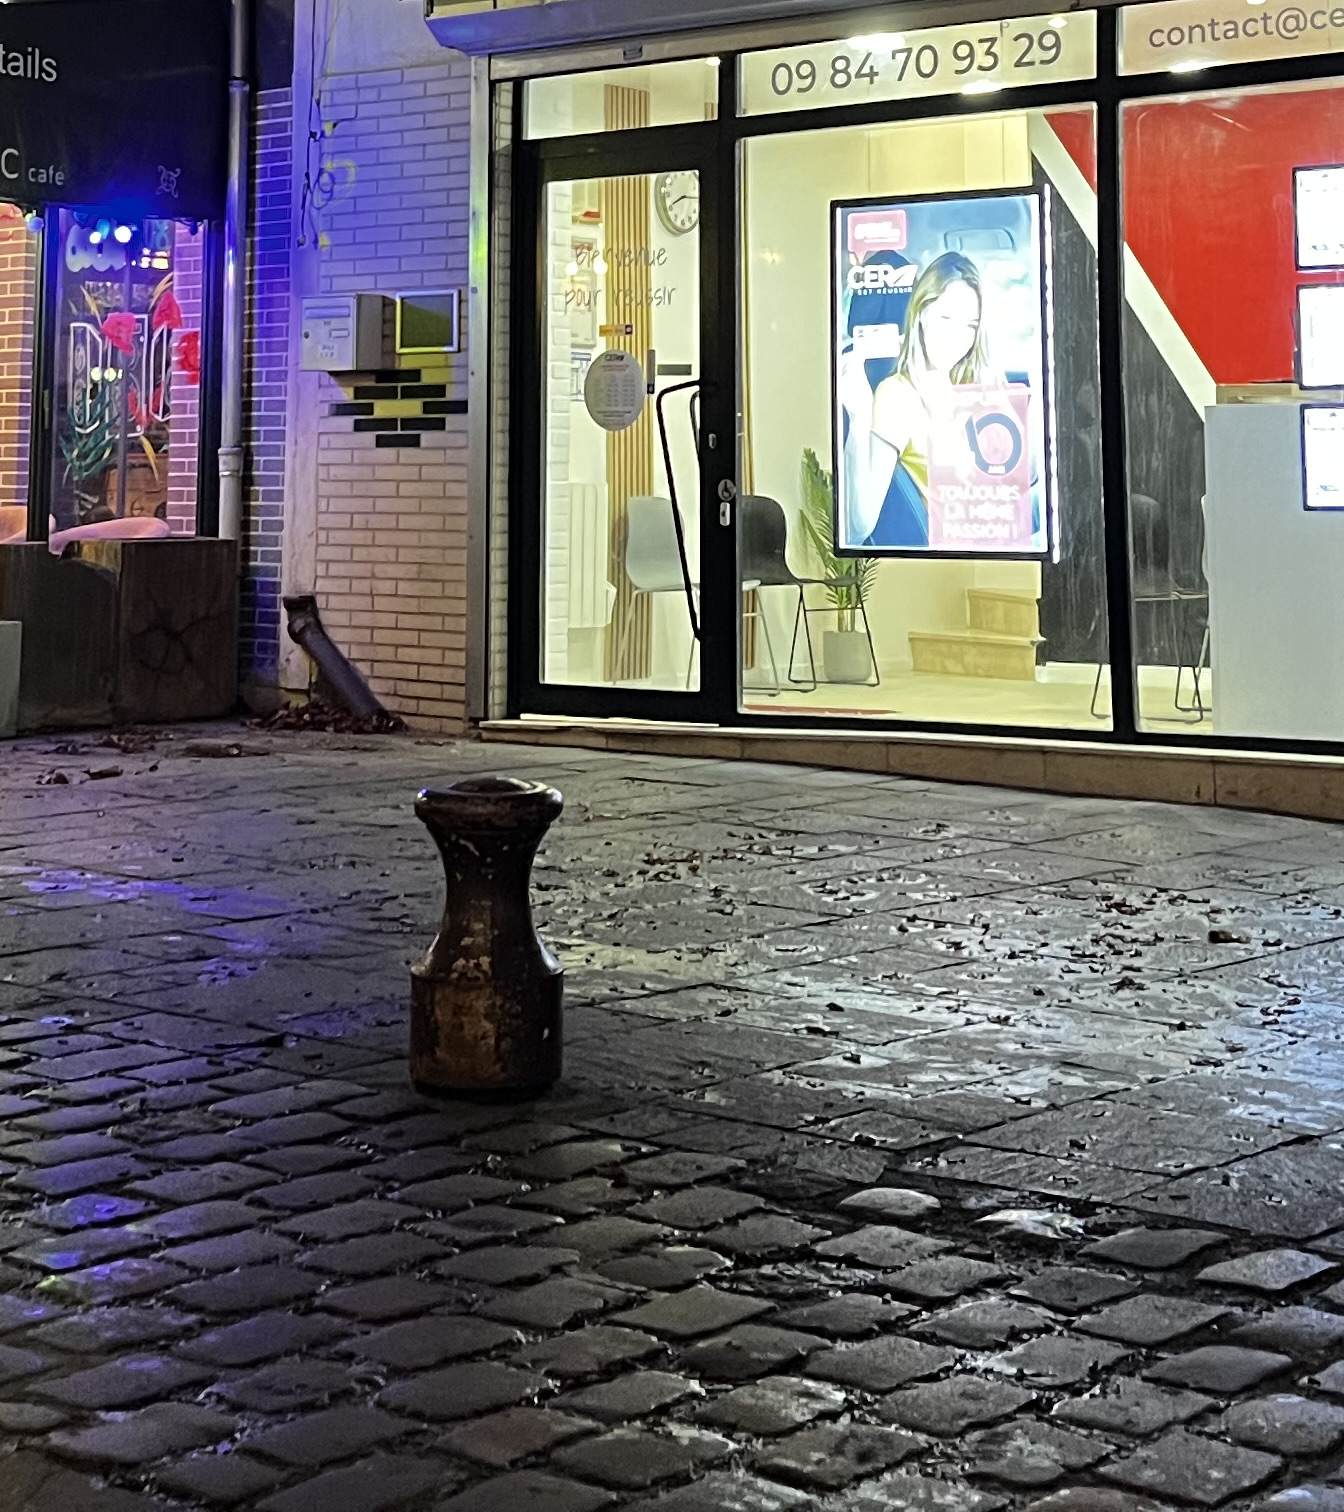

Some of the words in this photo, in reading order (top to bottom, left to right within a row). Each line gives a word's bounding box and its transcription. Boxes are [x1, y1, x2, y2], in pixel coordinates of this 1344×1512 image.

[771, 59, 817, 96] 09
[829, 51, 880, 89] 84
[891, 44, 939, 81] 70
[952, 36, 1000, 75] 93
[1012, 29, 1062, 68] 29
[28, 164, 65, 186] café
[574, 245, 669, 268] Bienvenue
[847, 264, 895, 290] CER
[564, 288, 602, 316] pour
[937, 484, 1021, 502] TOUJOURS
[944, 503, 966, 521] LA
[942, 522, 1010, 539] PASSION
